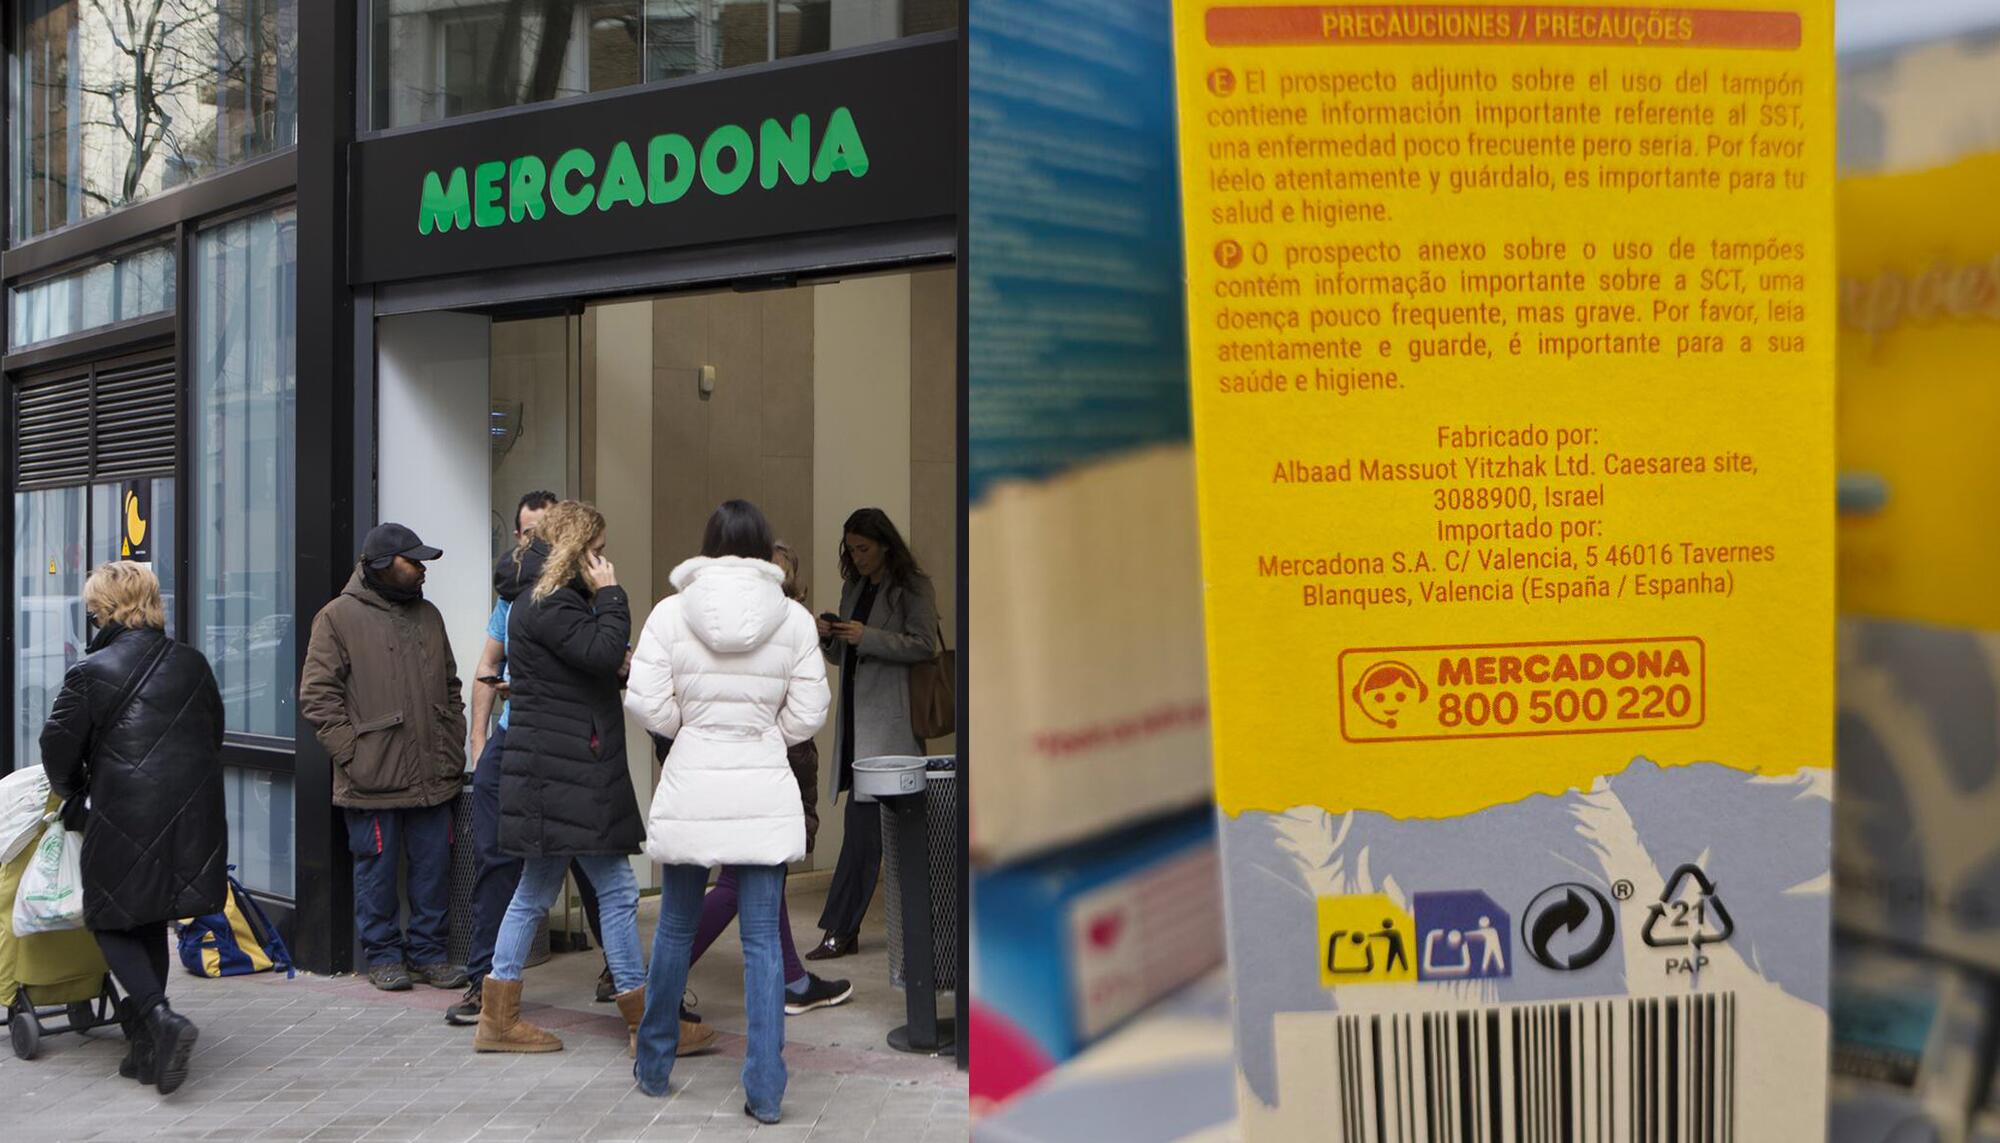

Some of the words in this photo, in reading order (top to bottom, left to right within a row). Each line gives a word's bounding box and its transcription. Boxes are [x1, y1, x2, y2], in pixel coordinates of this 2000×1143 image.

[1321, 11, 1511, 40] PRECAUCIONES
[1517, 13, 1528, 40] /
[1535, 9, 1694, 45] PRECAUÇÕES
[1244, 68, 1265, 94] El
[1279, 69, 1397, 99] prospecto
[1411, 67, 1498, 99] adjunto
[1512, 67, 1575, 92] sobre
[1588, 67, 1609, 92] el
[1622, 72, 1663, 93] uso
[1675, 67, 1708, 93] del
[1722, 69, 1806, 98] tampón
[1206, 103, 1308, 128] contiene
[1321, 99, 1461, 125] información
[1476, 99, 1601, 129] importante
[1615, 99, 1715, 126] referente
[1728, 101, 1748, 126] al
[1760, 101, 1807, 130] SST,
[1208, 138, 1250, 160] una
[1256, 131, 1396, 159] enfermedad
[1403, 136, 1461, 163] poco
[1466, 131, 1576, 157] frecuente
[1583, 135, 1632, 161] pero
[1639, 134, 1698, 157] seria.
[1707, 131, 1744, 158] Por
[1749, 132, 1804, 158] favor
[418, 106, 870, 237] MERCADONA
[1209, 167, 1265, 192] léelo
[1273, 165, 1421, 191] atentamente
[1429, 168, 1440, 194] y
[1449, 164, 1555, 194] guárdalo,
[1564, 167, 1590, 188] es
[1599, 164, 1721, 193] importante
[1729, 168, 1776, 194] para
[1783, 168, 1808, 189] tu
[1210, 198, 1274, 225] salud
[1280, 201, 1295, 223] e
[1301, 197, 1392, 229] higiene.
[1251, 240, 1268, 265] O
[1284, 240, 1401, 270] prospecto
[1418, 240, 1488, 262] anexo
[1503, 235, 1567, 261] sobre
[1583, 240, 1598, 260] o
[1613, 240, 1653, 260] uso
[1669, 236, 1696, 261] de
[1710, 237, 1805, 266] tampões
[1214, 272, 1301, 298] contém
[1314, 270, 1447, 299] informação
[1460, 269, 1586, 299] importante
[1599, 267, 1661, 292] sobre
[1674, 272, 1688, 292] a
[1700, 267, 1746, 294] SCT,
[1759, 271, 1807, 292] uma
[1214, 306, 1300, 334] doença
[1308, 306, 1381, 334] pouco
[1391, 298, 1507, 333] frequente,
[1517, 302, 1565, 324] mas
[1574, 303, 1642, 329] grave.
[1652, 298, 1690, 322] Por
[1699, 296, 1760, 325] favor,
[1768, 298, 1806, 322] leia
[1217, 336, 1363, 362] atentamente
[1378, 337, 1392, 358] e
[1408, 330, 1495, 363] guarde,
[1509, 331, 1522, 356] é
[1538, 332, 1661, 361] importante
[1677, 334, 1726, 360] para
[1740, 335, 1753, 353] a
[1768, 334, 1806, 352] sua
[1218, 368, 1288, 393] saúde
[1294, 373, 1308, 392] e
[1313, 367, 1405, 397] higiene.
[1437, 425, 1549, 449] Fabricado
[1555, 427, 1600, 453] por:
[1272, 460, 1351, 484] Albaad
[1358, 456, 1457, 482] Massuot
[1464, 454, 1547, 479] Yitzhak
[1554, 454, 1596, 477] Ltd.
[1603, 451, 1708, 476] Caesarea
[1713, 450, 1758, 477] site,
[1433, 487, 1538, 512] 3088900,
[1544, 484, 1605, 509] Israel
[1436, 518, 1552, 545] Importado
[1558, 518, 1604, 544] por:
[1257, 553, 1385, 578] Mercadona
[1391, 551, 1437, 574] S.A.
[1443, 549, 1471, 574] C/
[1478, 547, 1579, 574] Valencia,
[1585, 546, 1599, 569] 5
[1605, 544, 1673, 568] 46016
[1679, 542, 1776, 566] Tavernes
[1303, 582, 1413, 610] Blanques,
[1419, 579, 1515, 604] Valencia
[1521, 576, 1611, 607] (España
[1616, 575, 1626, 599] /
[1633, 571, 1735, 600] Espanha)
[1437, 649, 1691, 686] MERCADONA
[1438, 688, 1519, 728] 800
[1529, 686, 1609, 724] 500
[1617, 684, 1691, 720] 220
[1671, 899, 1704, 927] 21
[1665, 956, 1709, 975] PAP
